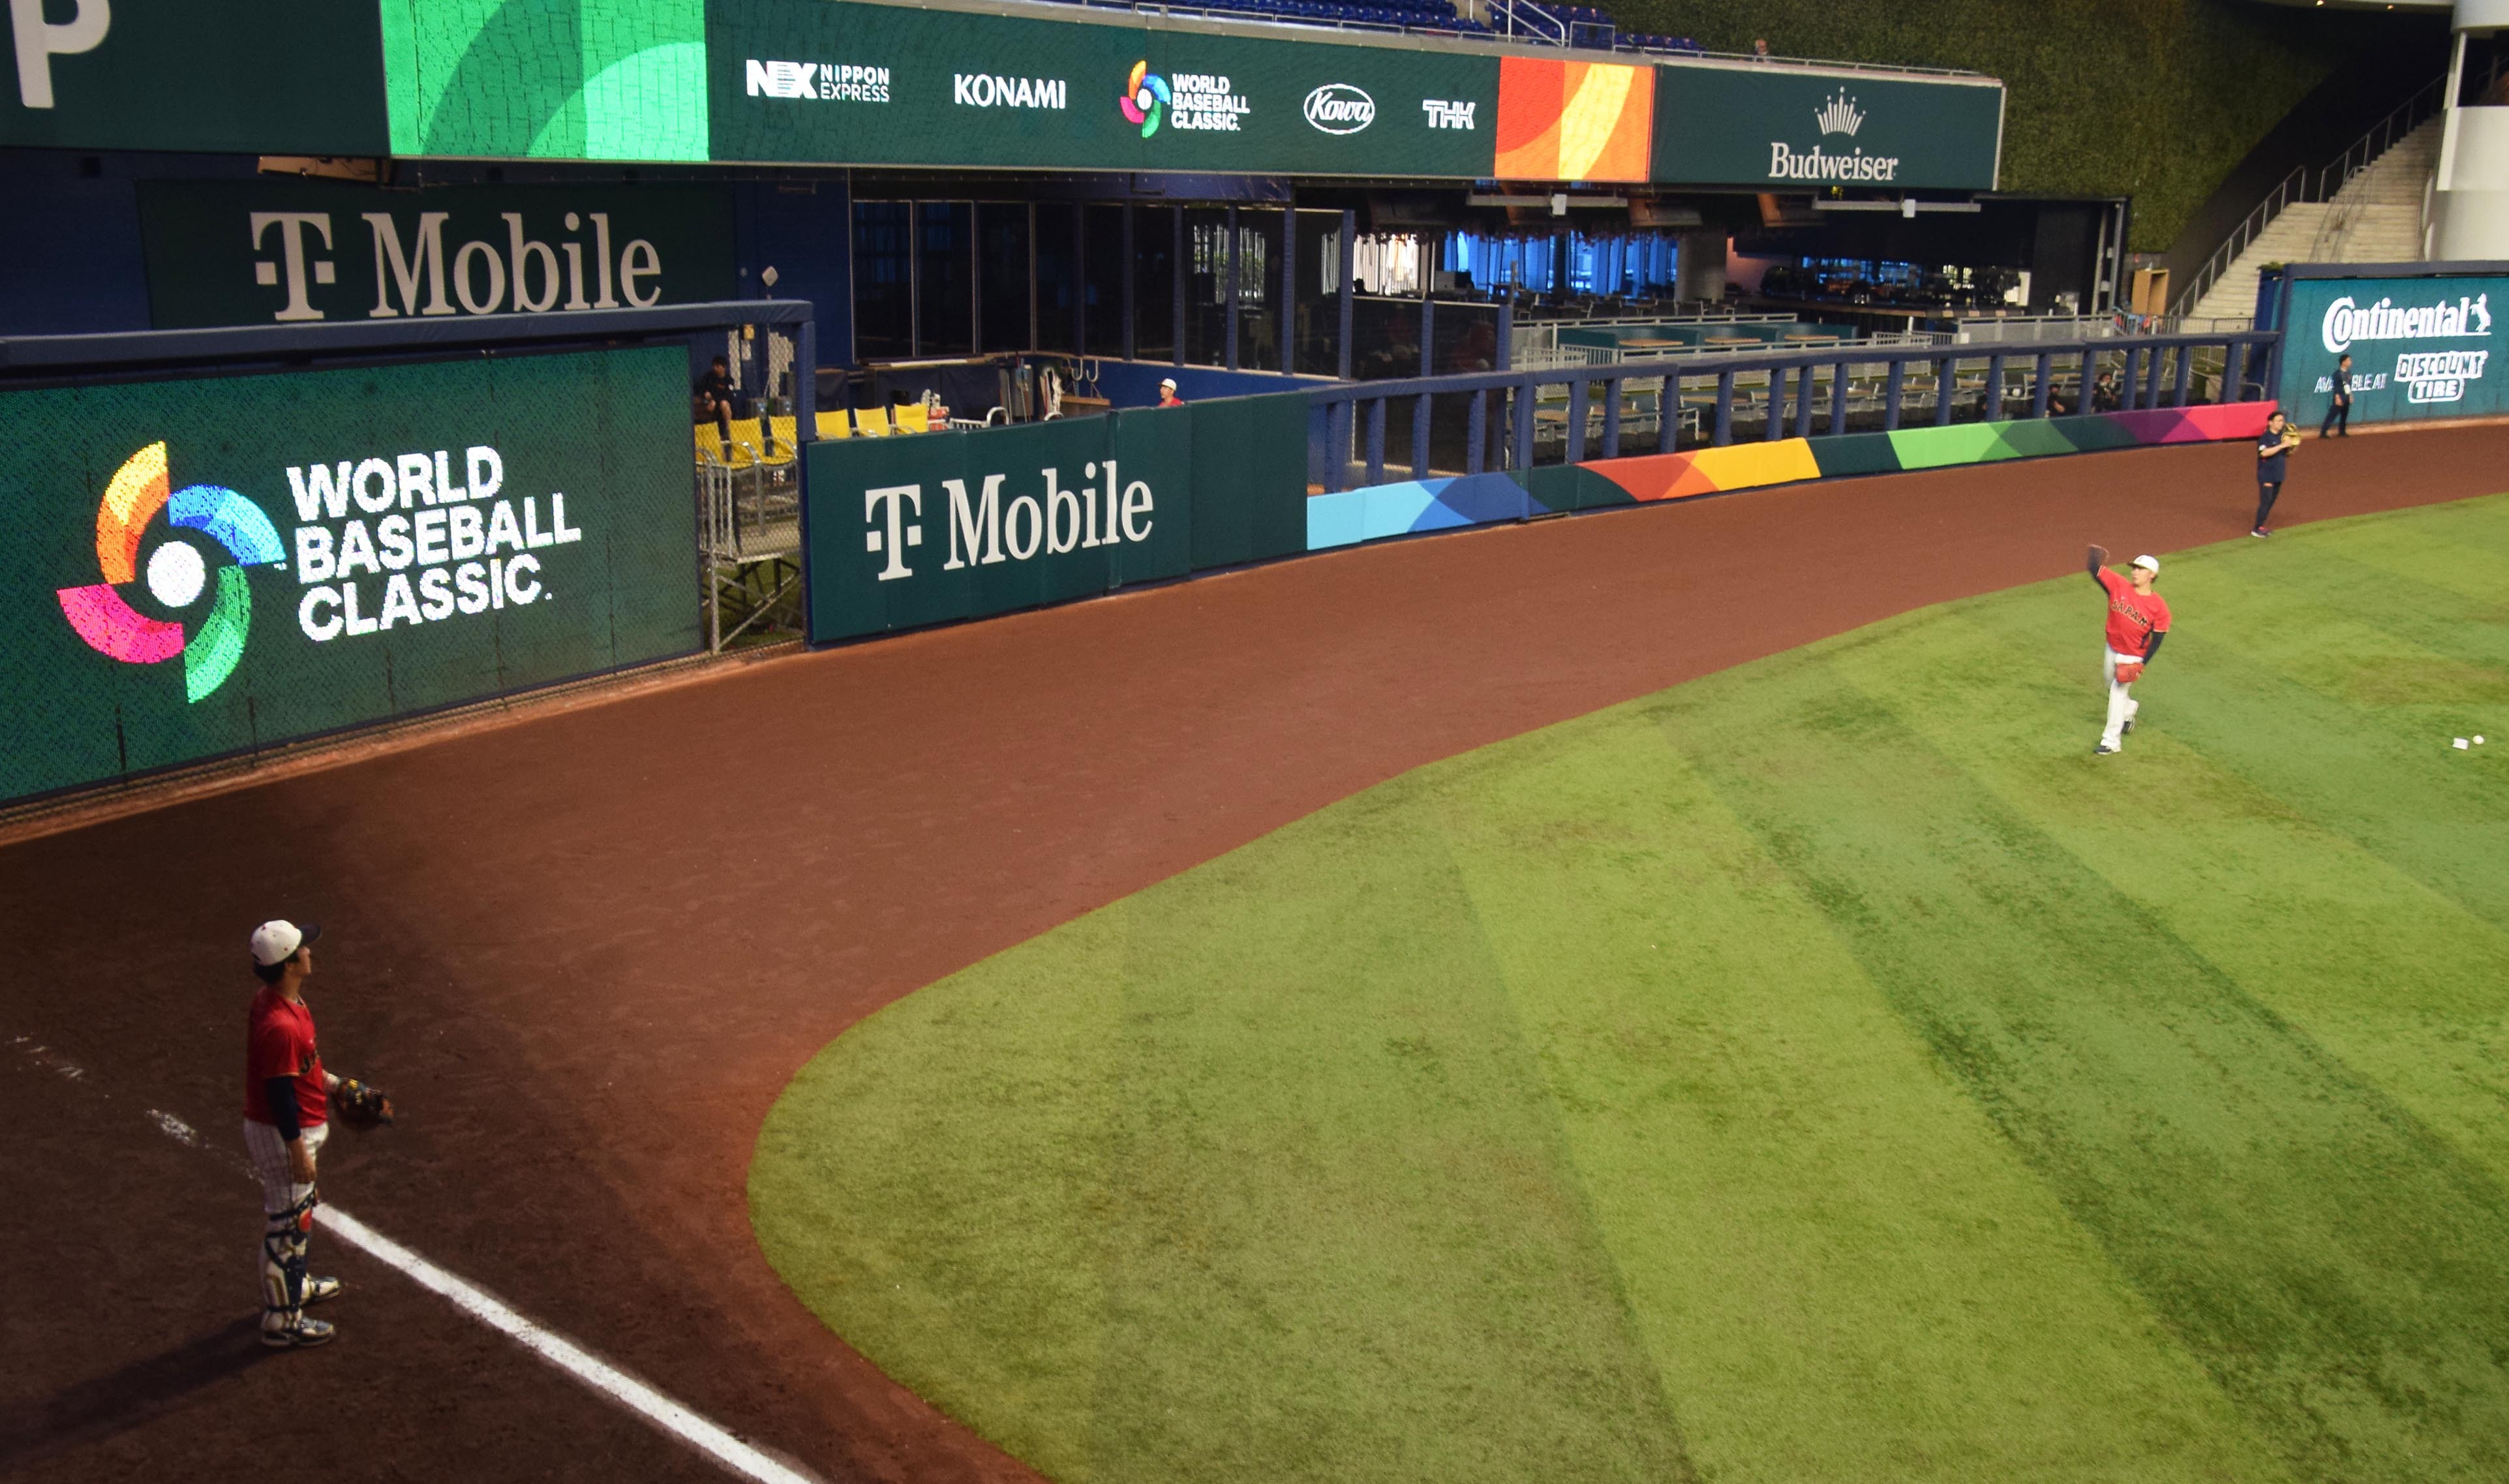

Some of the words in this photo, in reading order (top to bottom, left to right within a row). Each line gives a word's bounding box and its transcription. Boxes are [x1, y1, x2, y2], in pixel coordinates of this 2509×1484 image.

[820, 64, 890, 85] NIPPON
[1172, 74, 1230, 95] WORLD
[820, 84, 890, 102] EXPRESS
[954, 73, 1066, 109] KONAMI
[1172, 93, 1251, 113] BASEBALL
[1310, 91, 1373, 121] Kowa
[1422, 100, 1476, 130] THK
[1769, 142, 1899, 181] Budweiser
[361, 212, 661, 318] Mobile
[2322, 295, 2471, 353] Continental
[2372, 373, 2388, 389] AT
[2394, 350, 2489, 382] DISCOUNT
[2415, 380, 2458, 399] TIRE
[286, 446, 504, 522] WORLD
[942, 460, 1153, 570] Mobile
[296, 492, 582, 584] BASEBALL
[2111, 599, 2148, 626] JAPAN
